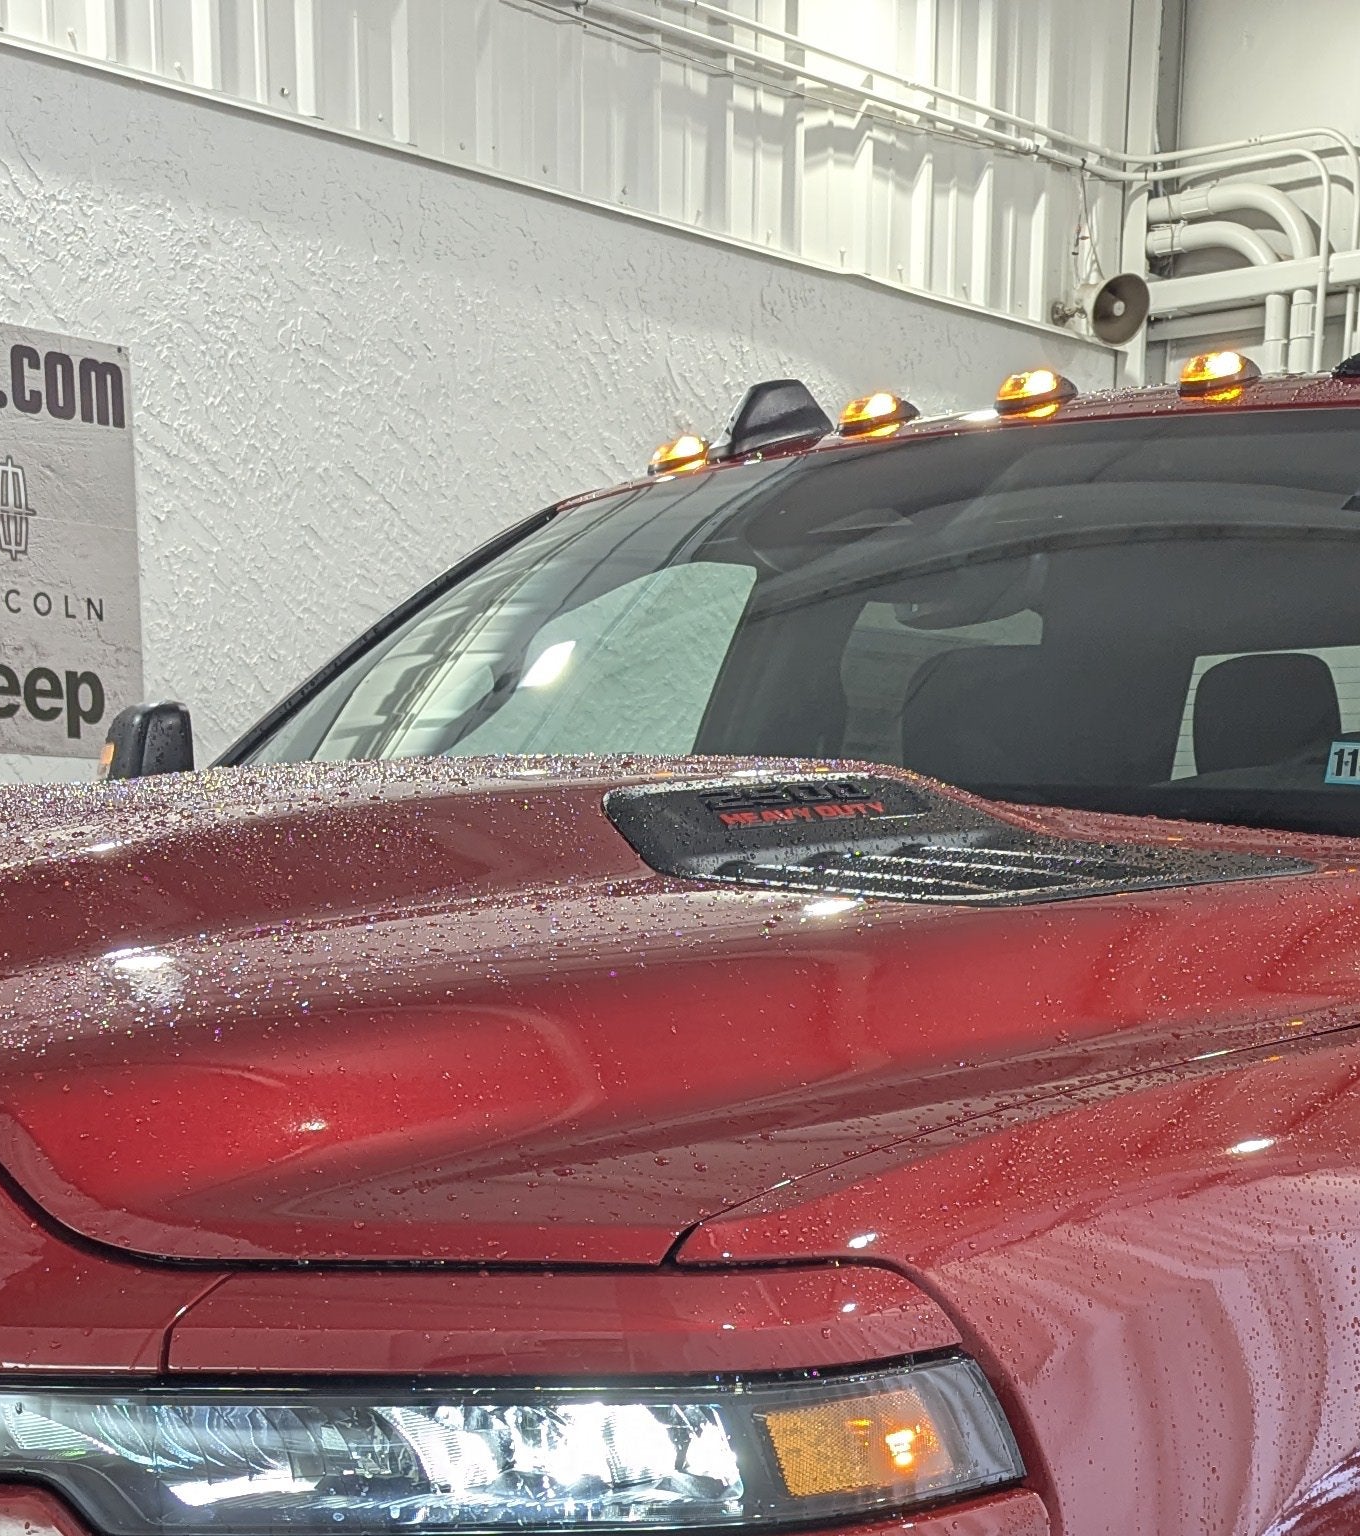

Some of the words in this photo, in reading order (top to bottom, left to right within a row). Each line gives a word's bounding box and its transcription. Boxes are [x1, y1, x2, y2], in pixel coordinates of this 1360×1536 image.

[1334, 748, 1359, 777] 11
[719, 807, 812, 829] HEAVY
[812, 801, 885, 821] DUTY
